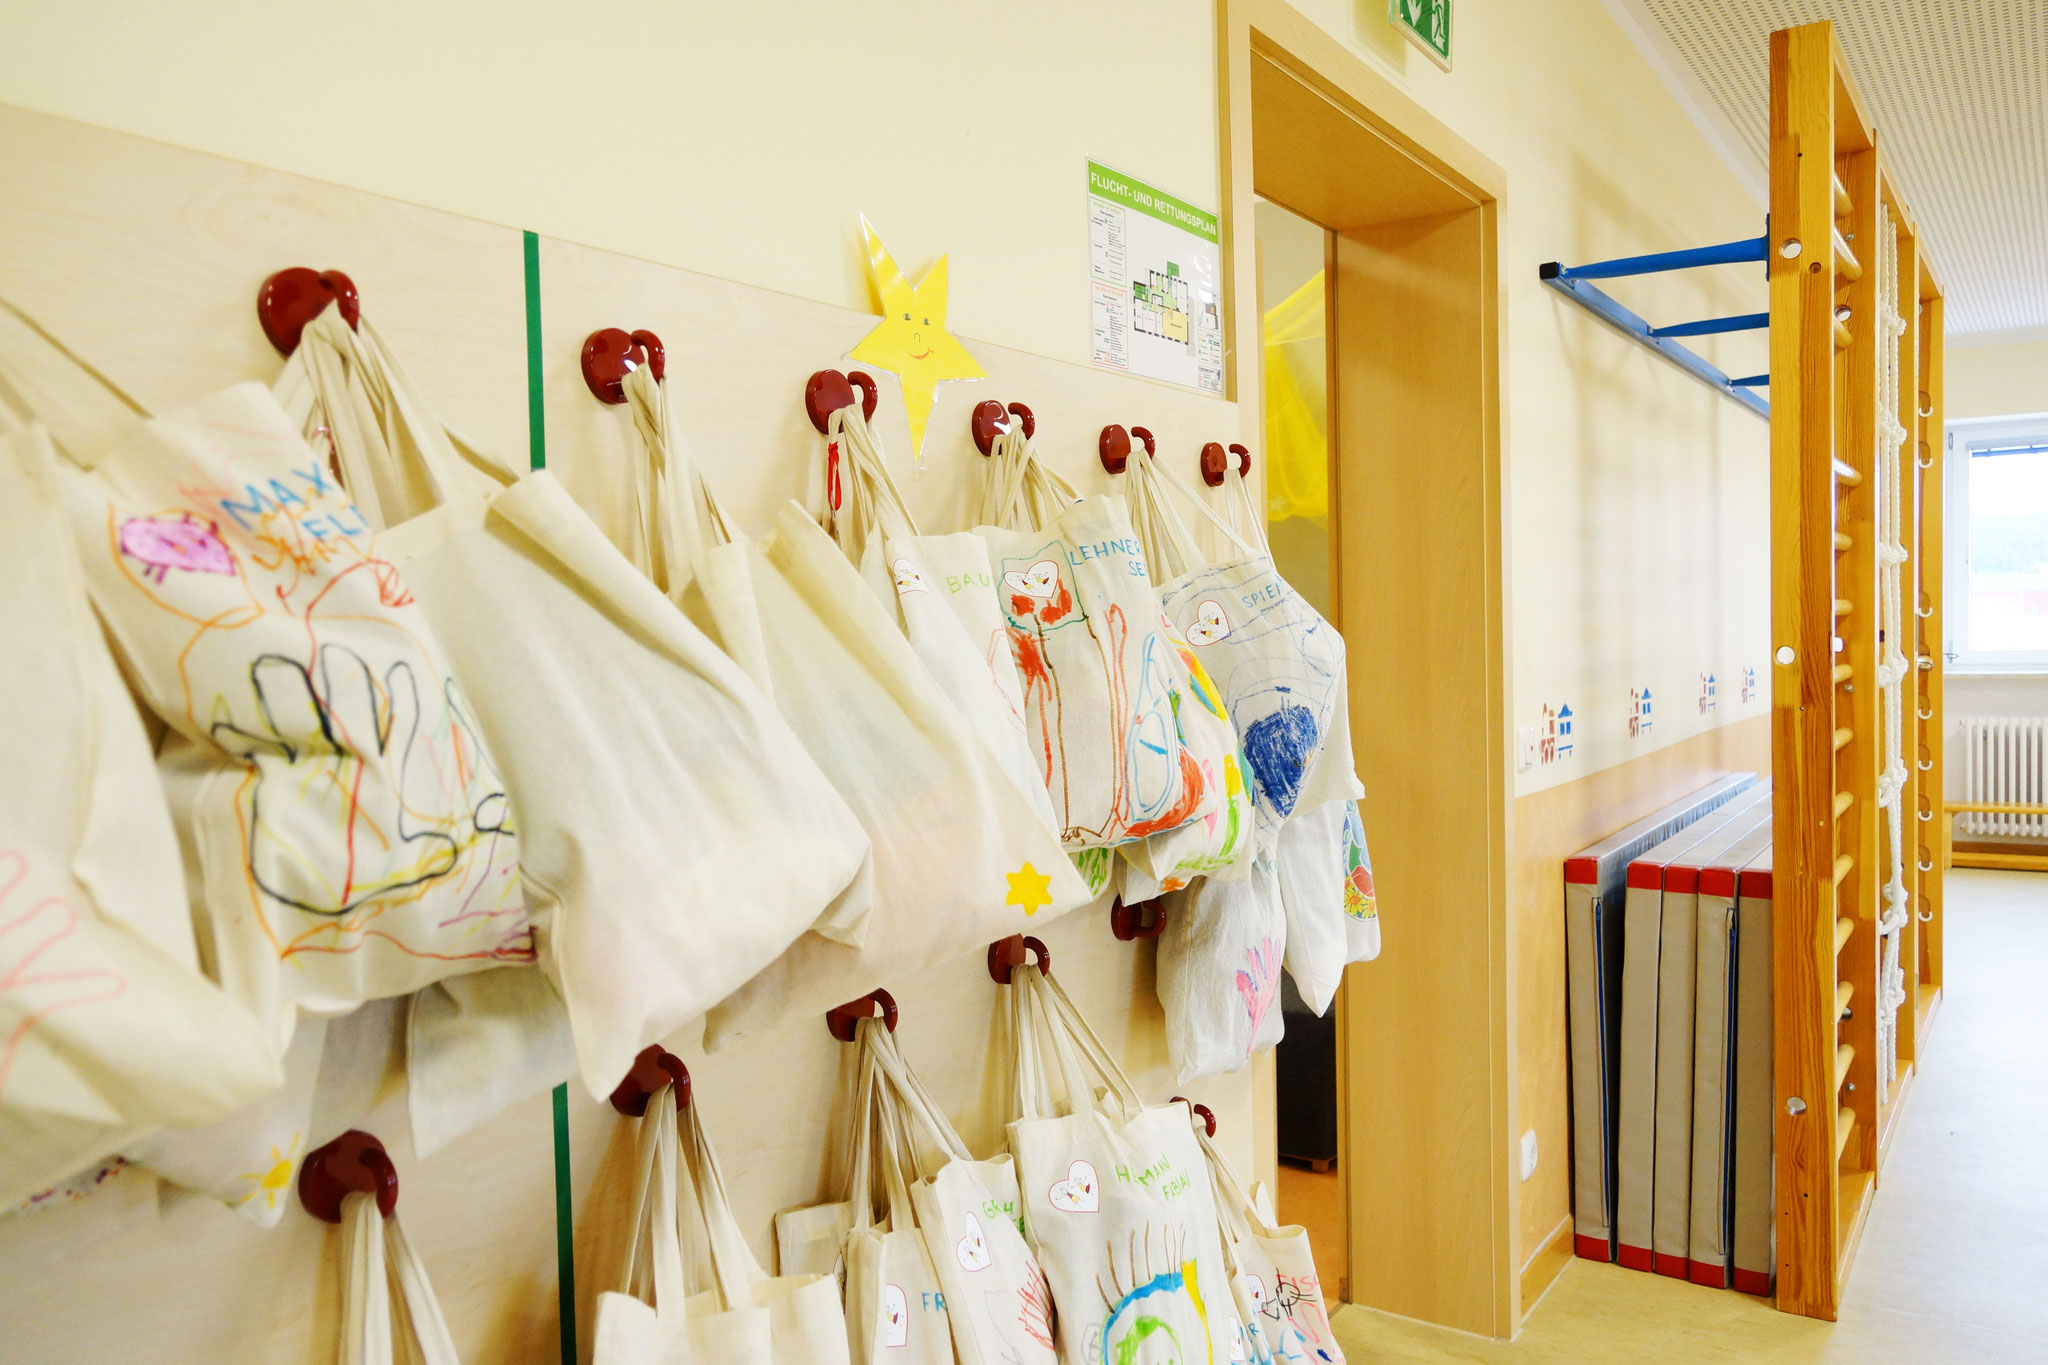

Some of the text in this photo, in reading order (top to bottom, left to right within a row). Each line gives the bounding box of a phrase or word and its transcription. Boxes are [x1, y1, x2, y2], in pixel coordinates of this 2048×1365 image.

[1091, 172, 1132, 197] FLUCHT-
[1133, 189, 1152, 207] UND
[1154, 198, 1216, 236] RETTUNGSPLAN
[220, 461, 333, 531] MAX
